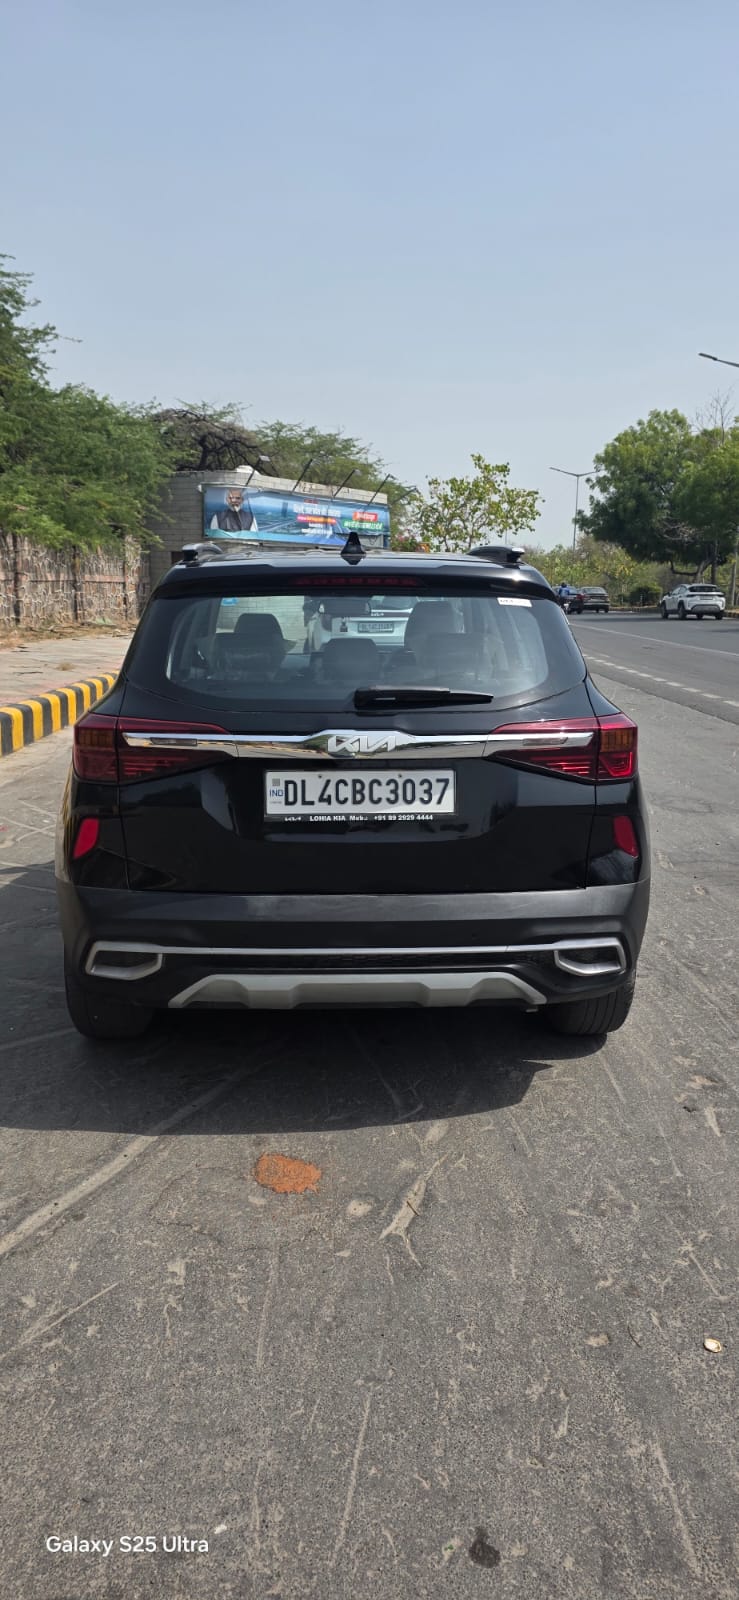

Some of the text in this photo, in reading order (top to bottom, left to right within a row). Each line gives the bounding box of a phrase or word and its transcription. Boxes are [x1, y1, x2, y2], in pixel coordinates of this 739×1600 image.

[327, 734, 396, 753] KIA
[269, 788, 284, 797] IND
[284, 778, 450, 806] DL4CBC3037
